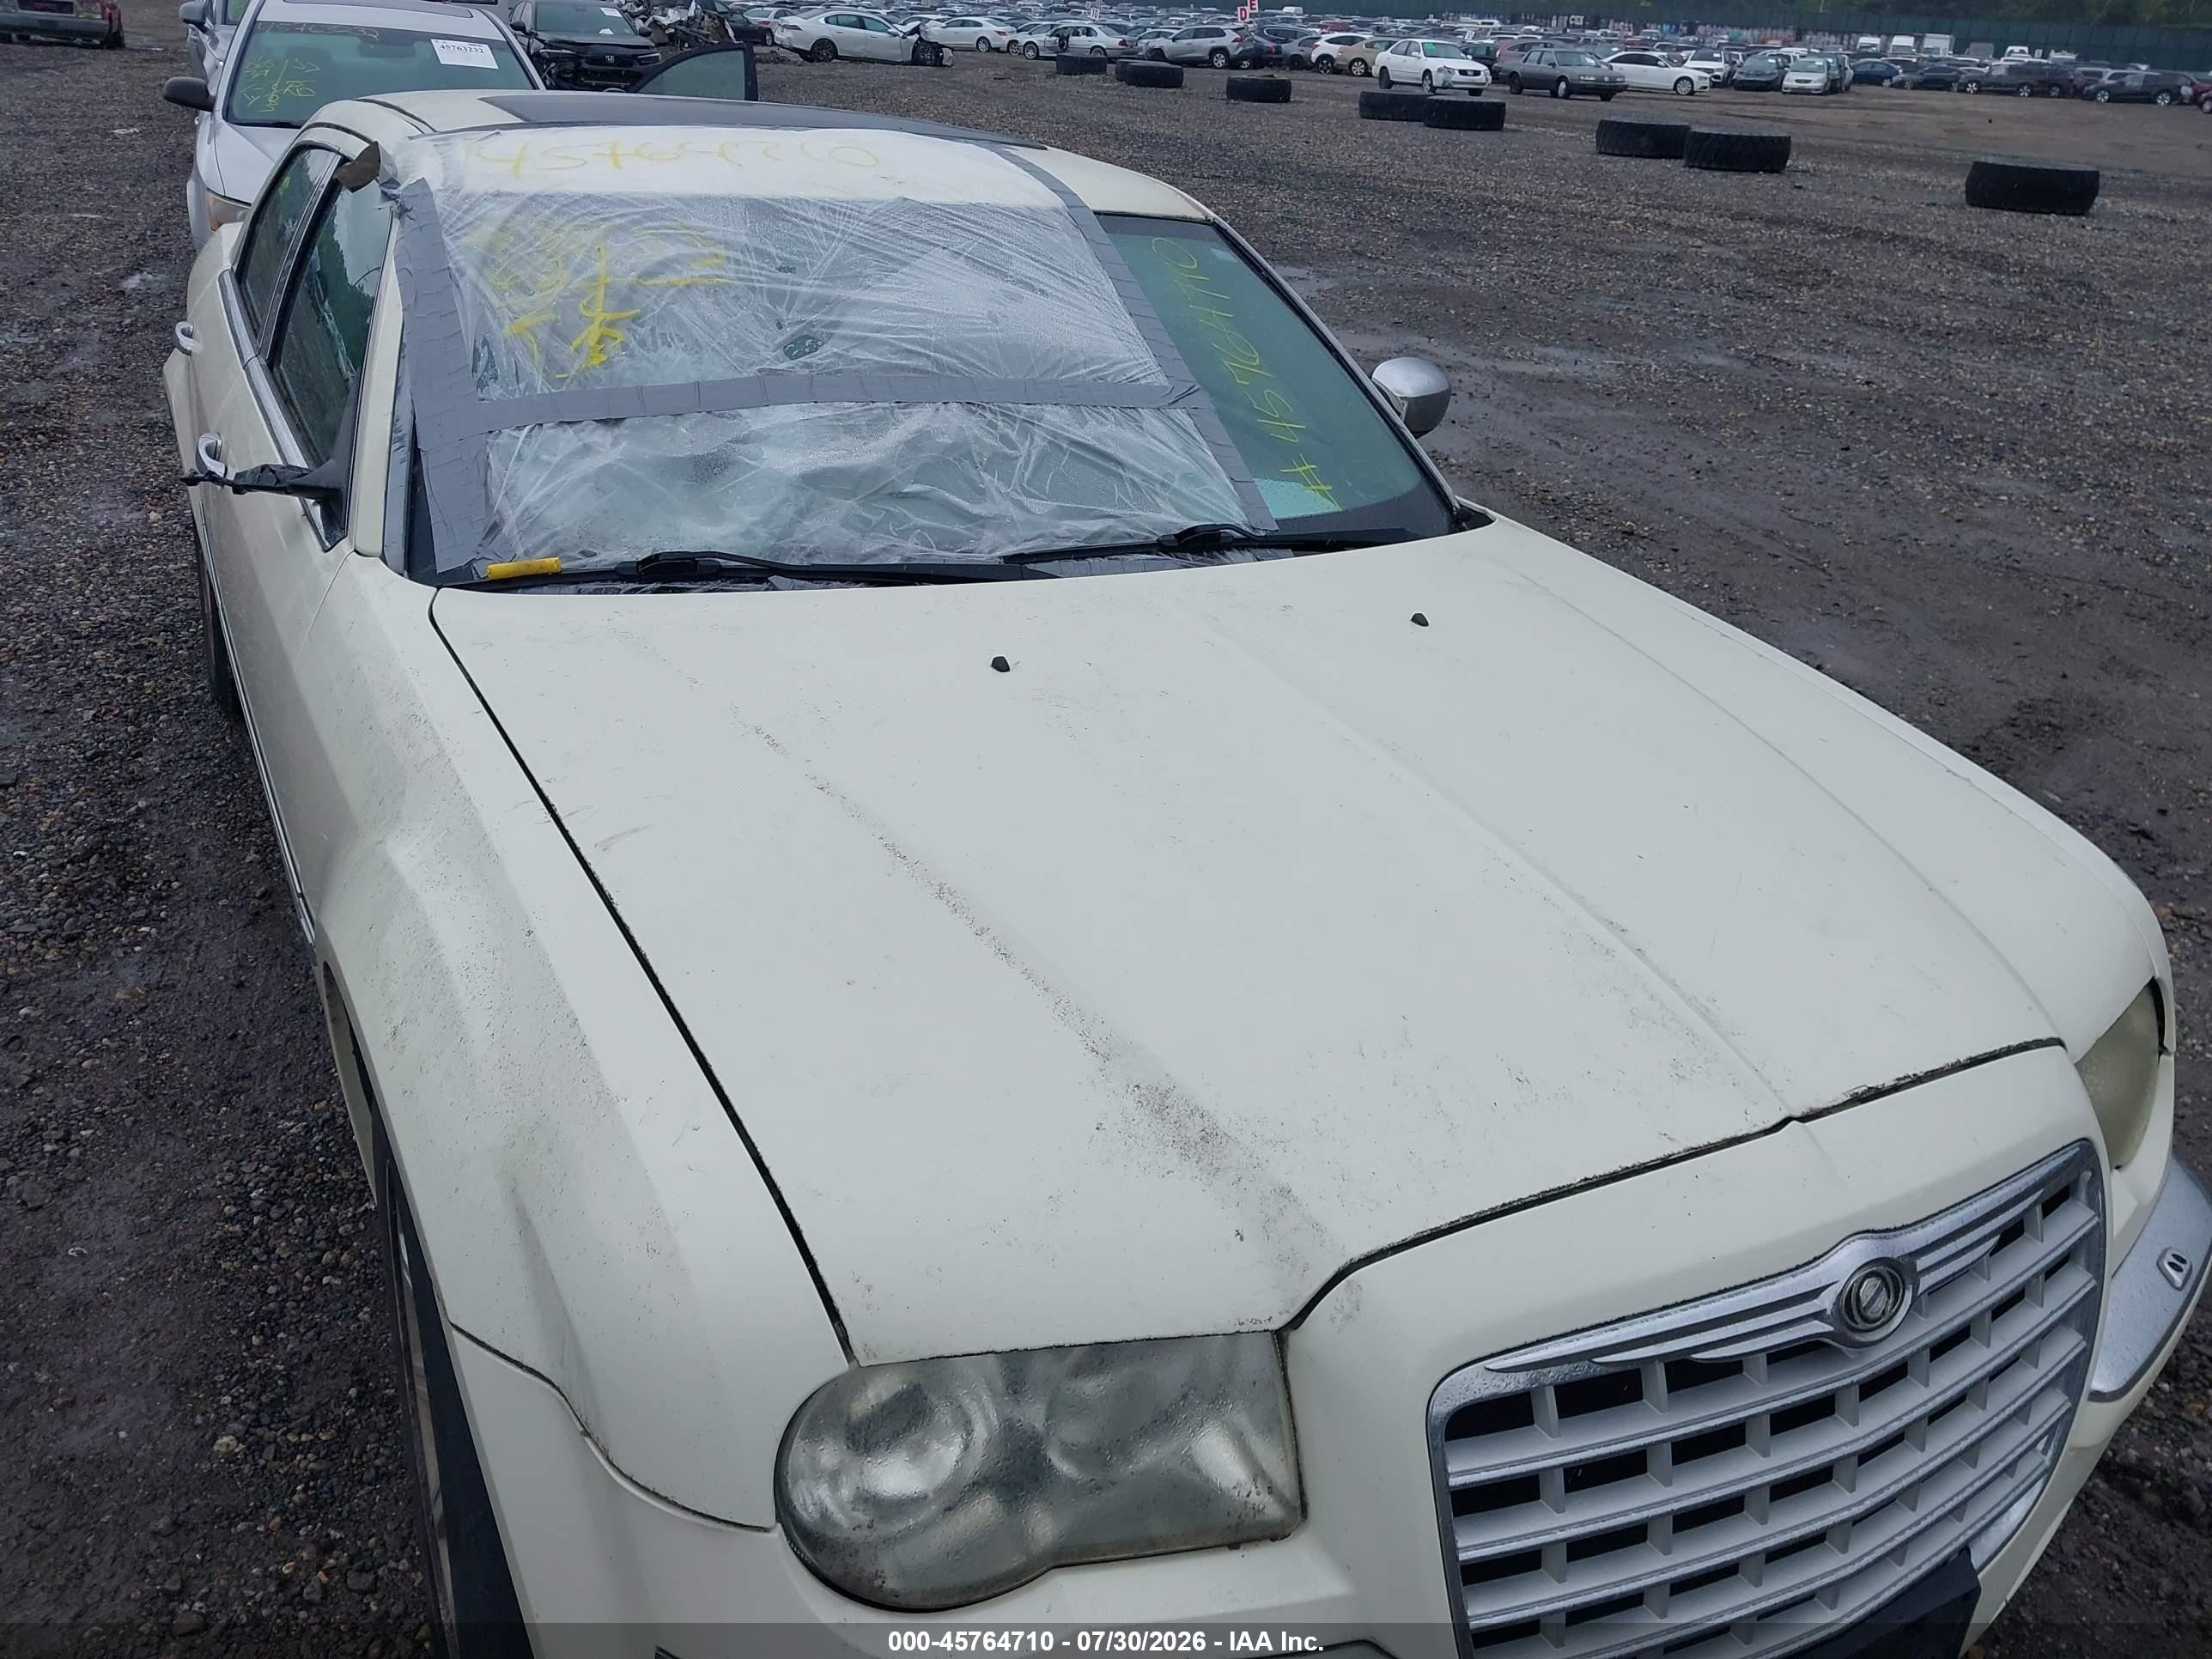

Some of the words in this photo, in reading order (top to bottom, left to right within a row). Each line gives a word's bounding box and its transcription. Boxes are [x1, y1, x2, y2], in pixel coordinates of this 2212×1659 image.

[1249, 0, 1256, 10] E
[1240, 8, 1248, 21] D
[440, 44, 485, 54] 45763232
